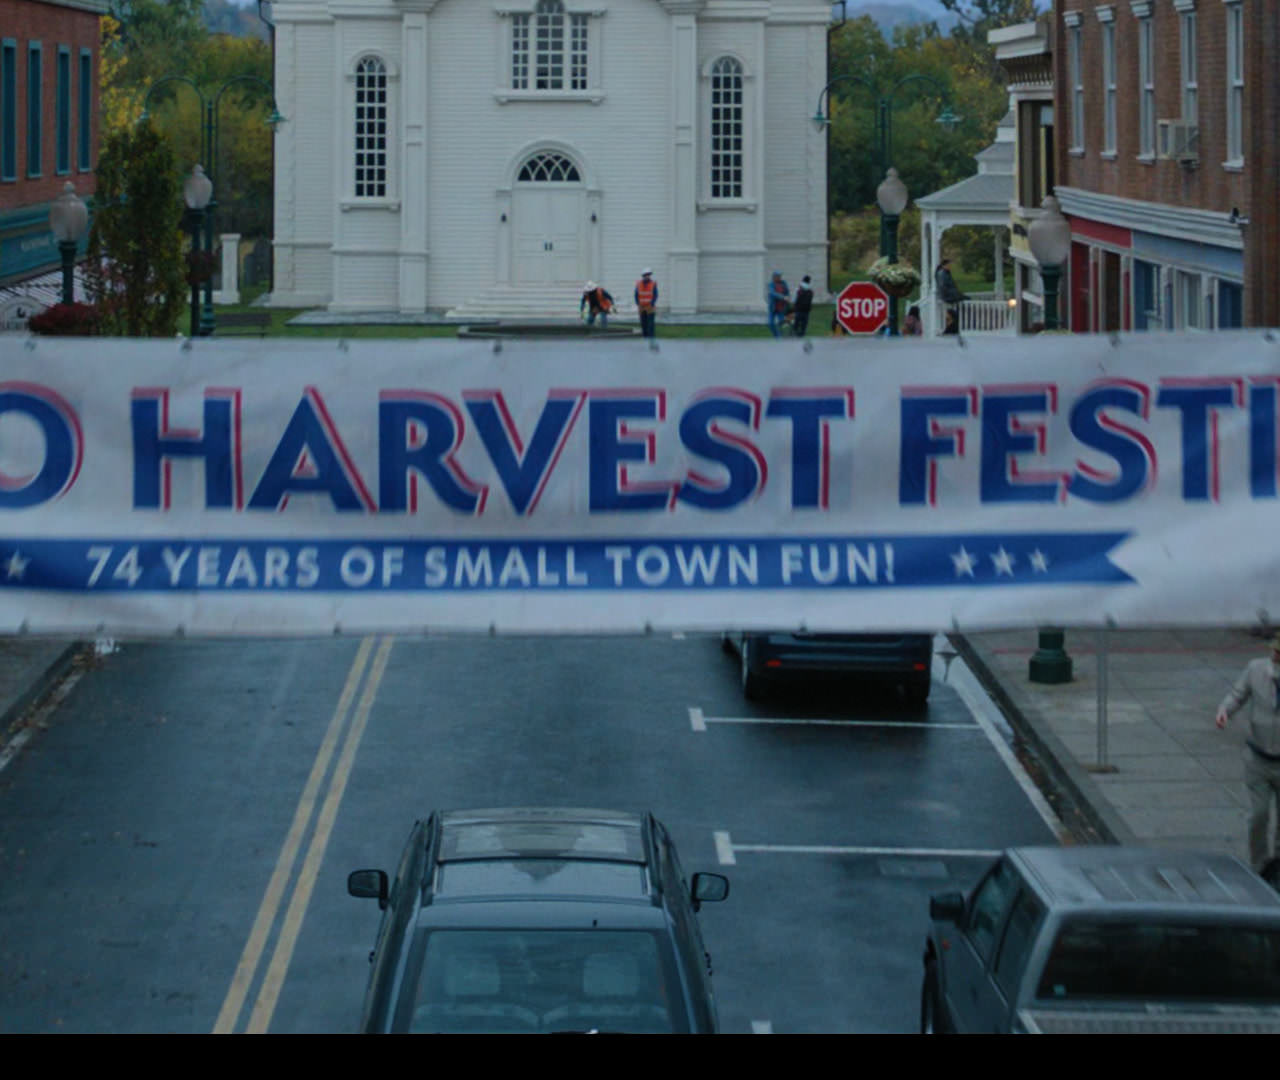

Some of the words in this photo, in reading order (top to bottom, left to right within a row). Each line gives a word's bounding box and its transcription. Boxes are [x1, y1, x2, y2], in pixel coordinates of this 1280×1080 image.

[840, 298, 886, 318] STOP
[130, 386, 856, 516] HARVEST
[86, 546, 141, 586] 74
[162, 547, 320, 588] YEARS
[339, 547, 405, 587] OF
[424, 548, 589, 587] SMALL
[605, 546, 760, 587] TOWN
[780, 543, 895, 584] FUN!
